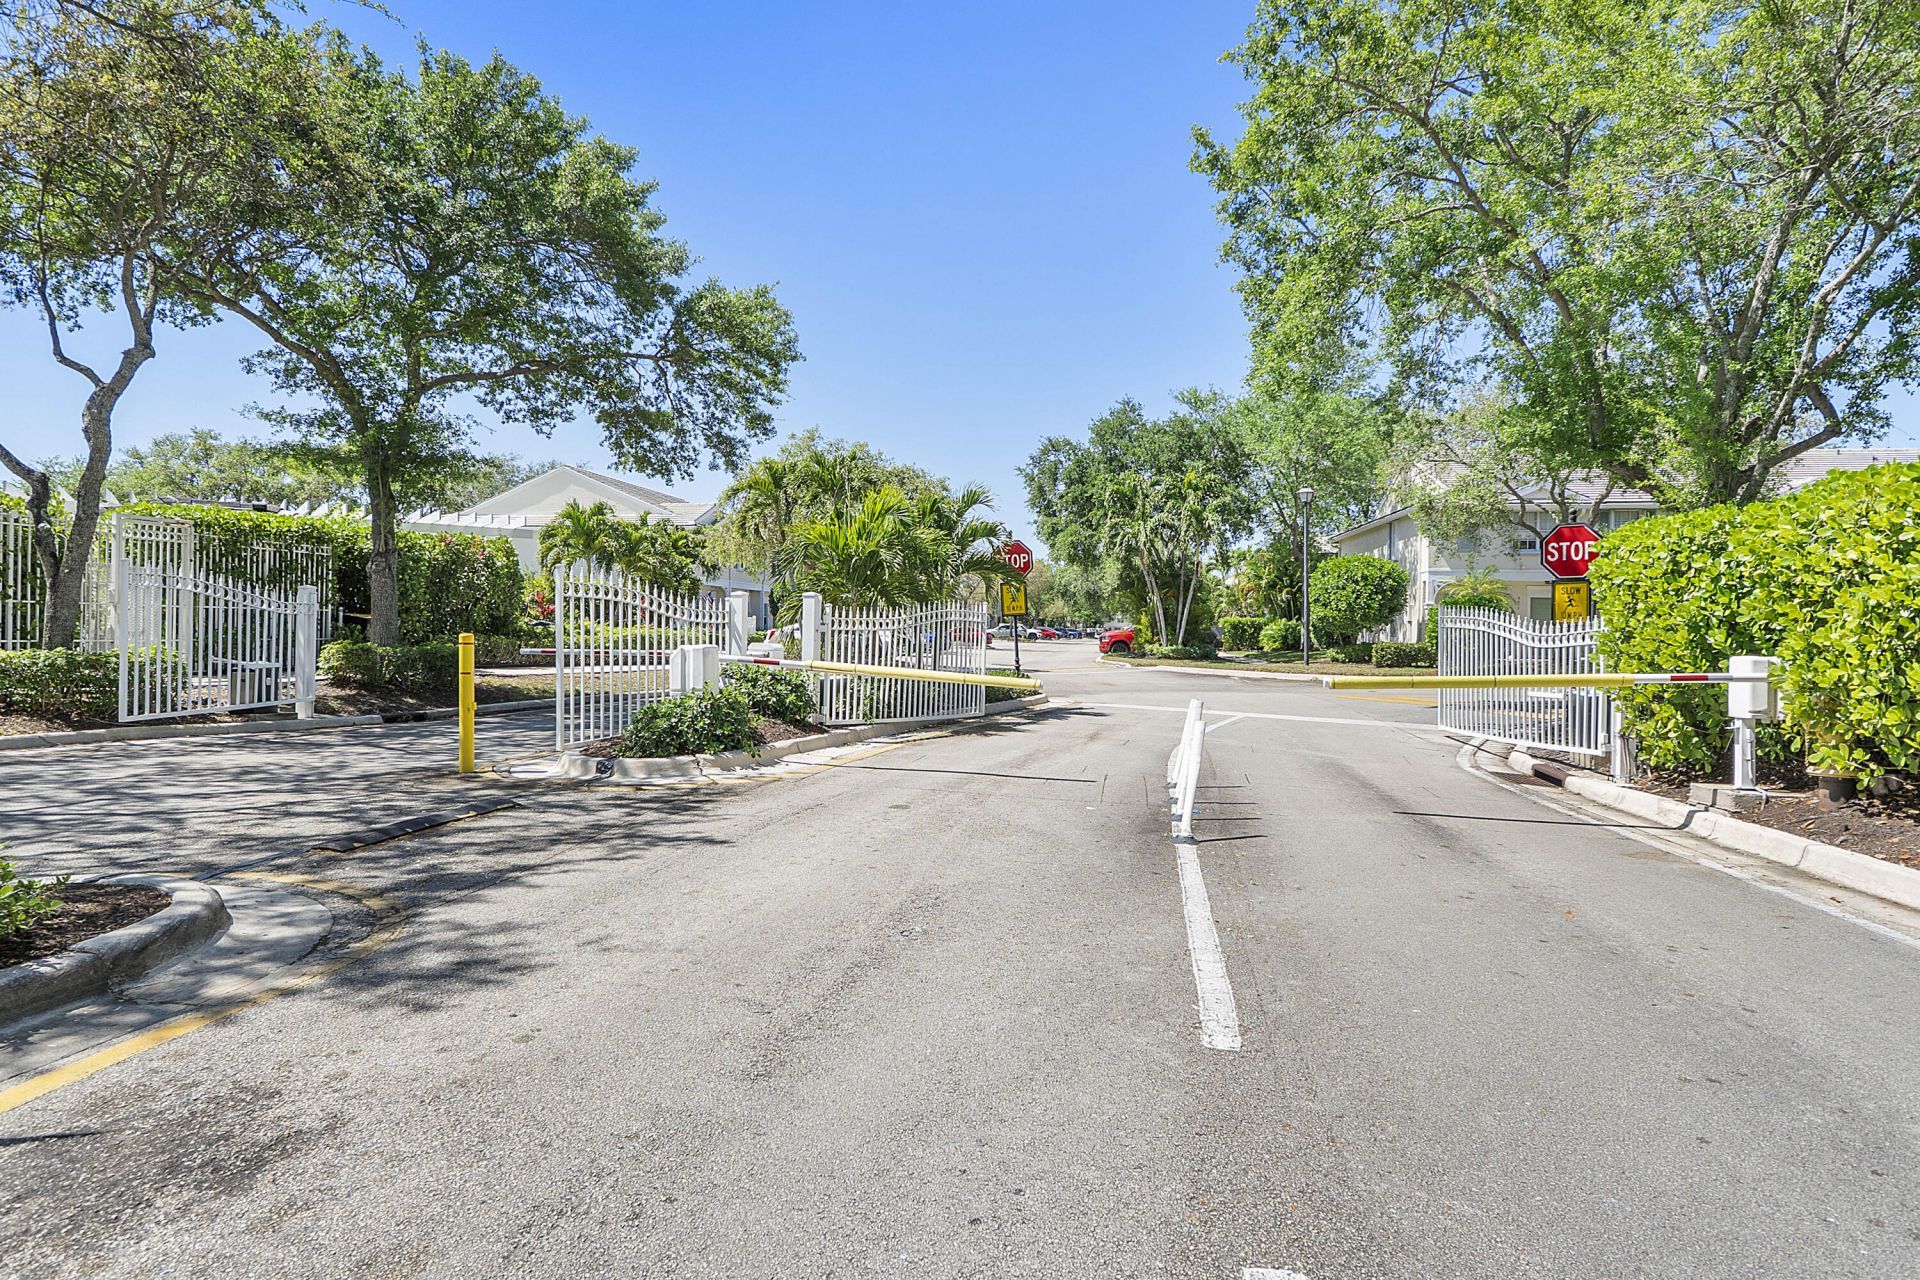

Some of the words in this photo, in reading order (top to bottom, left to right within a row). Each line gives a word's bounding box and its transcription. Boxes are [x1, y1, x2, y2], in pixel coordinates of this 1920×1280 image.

[1546, 540, 1598, 562] STOP
[1002, 553, 1029, 568] TOP
[1561, 586, 1582, 595] SLOW
